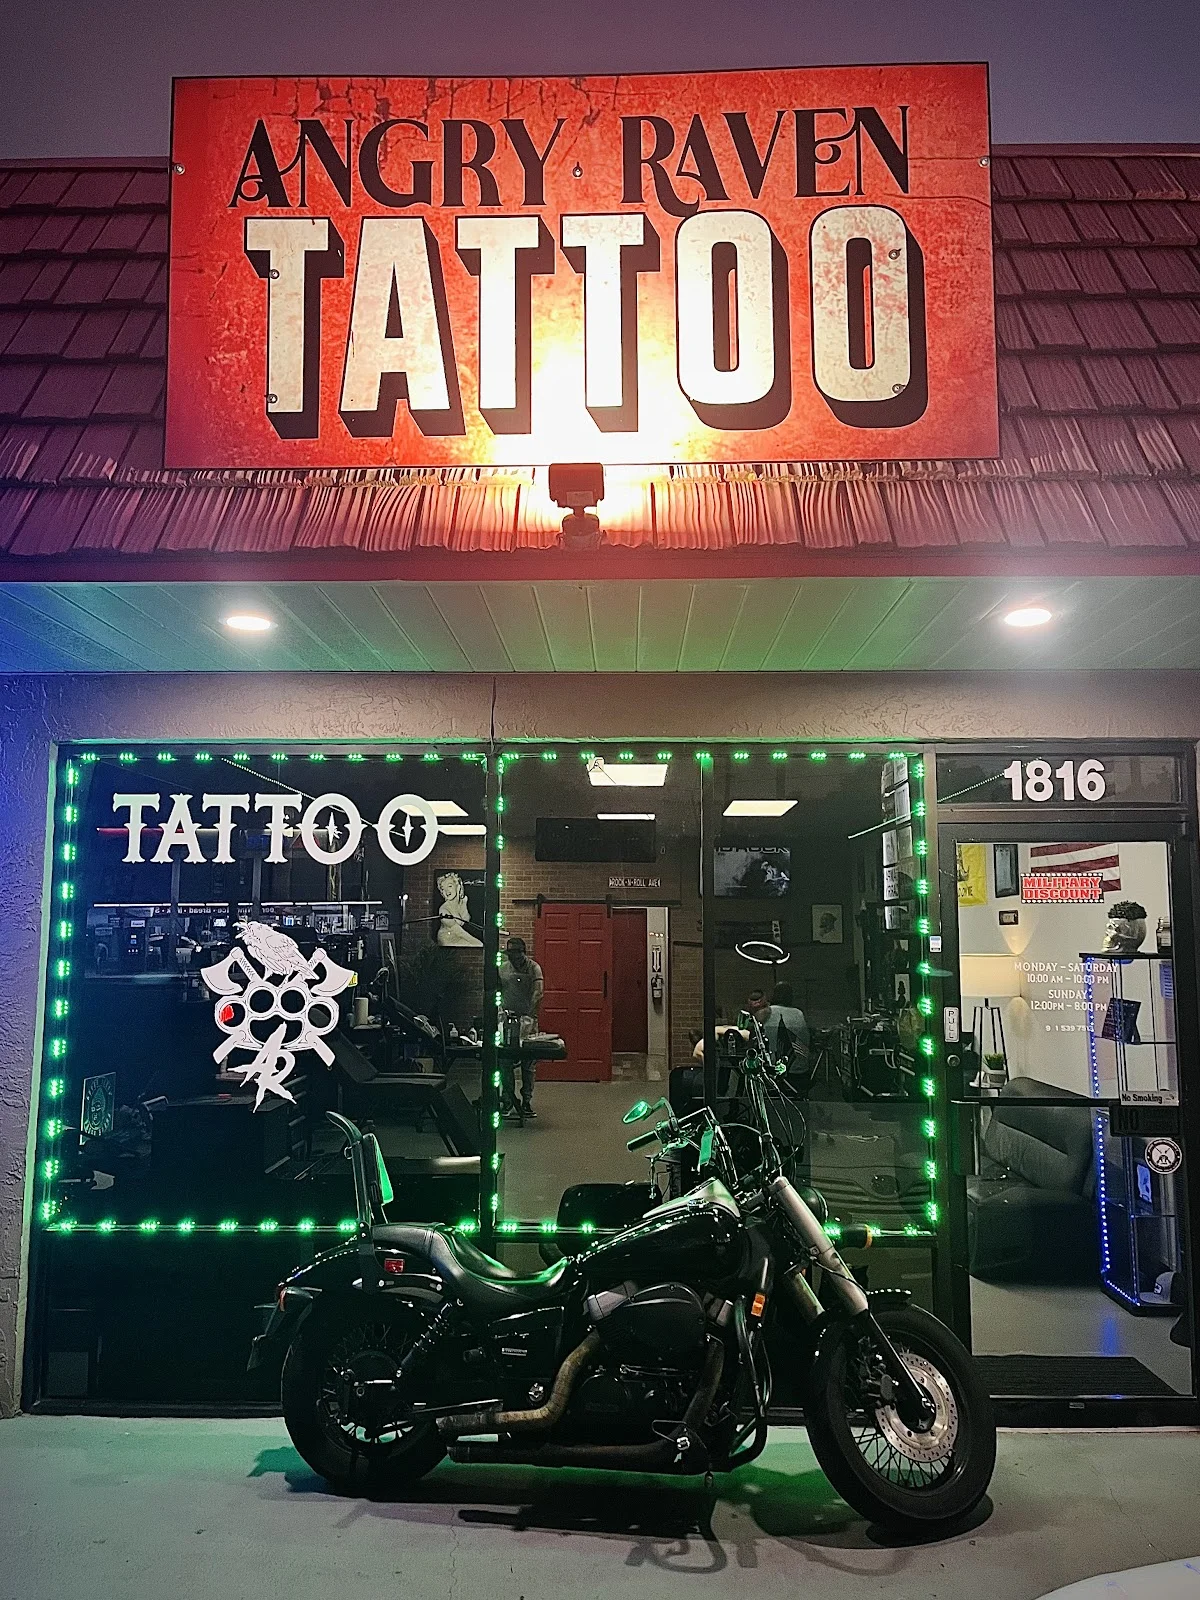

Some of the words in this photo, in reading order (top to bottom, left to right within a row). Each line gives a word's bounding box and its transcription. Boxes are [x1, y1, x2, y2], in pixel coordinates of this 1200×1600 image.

[229, 117, 566, 208] ANGRY
[620, 105, 910, 218] RAVEN
[246, 205, 927, 439] TATTOO
[1004, 759, 1106, 801] 1816
[113, 792, 439, 866] TATTOO
[1022, 877, 1101, 889] MILITARY
[1022, 888, 1102, 899] DISCOUNT
[1014, 963, 1057, 972] MONDAY
[1068, 963, 1118, 972] SATURDAY
[1027, 974, 1048, 983] 10:00
[1097, 976, 1109, 984] PM
[1048, 990, 1087, 999] SUNDAY
[1031, 1001, 1064, 1010] 12:00PM
[1095, 1003, 1107, 1011] PM
[1122, 1094, 1131, 1102] No
[1132, 1093, 1162, 1104] Smoking
